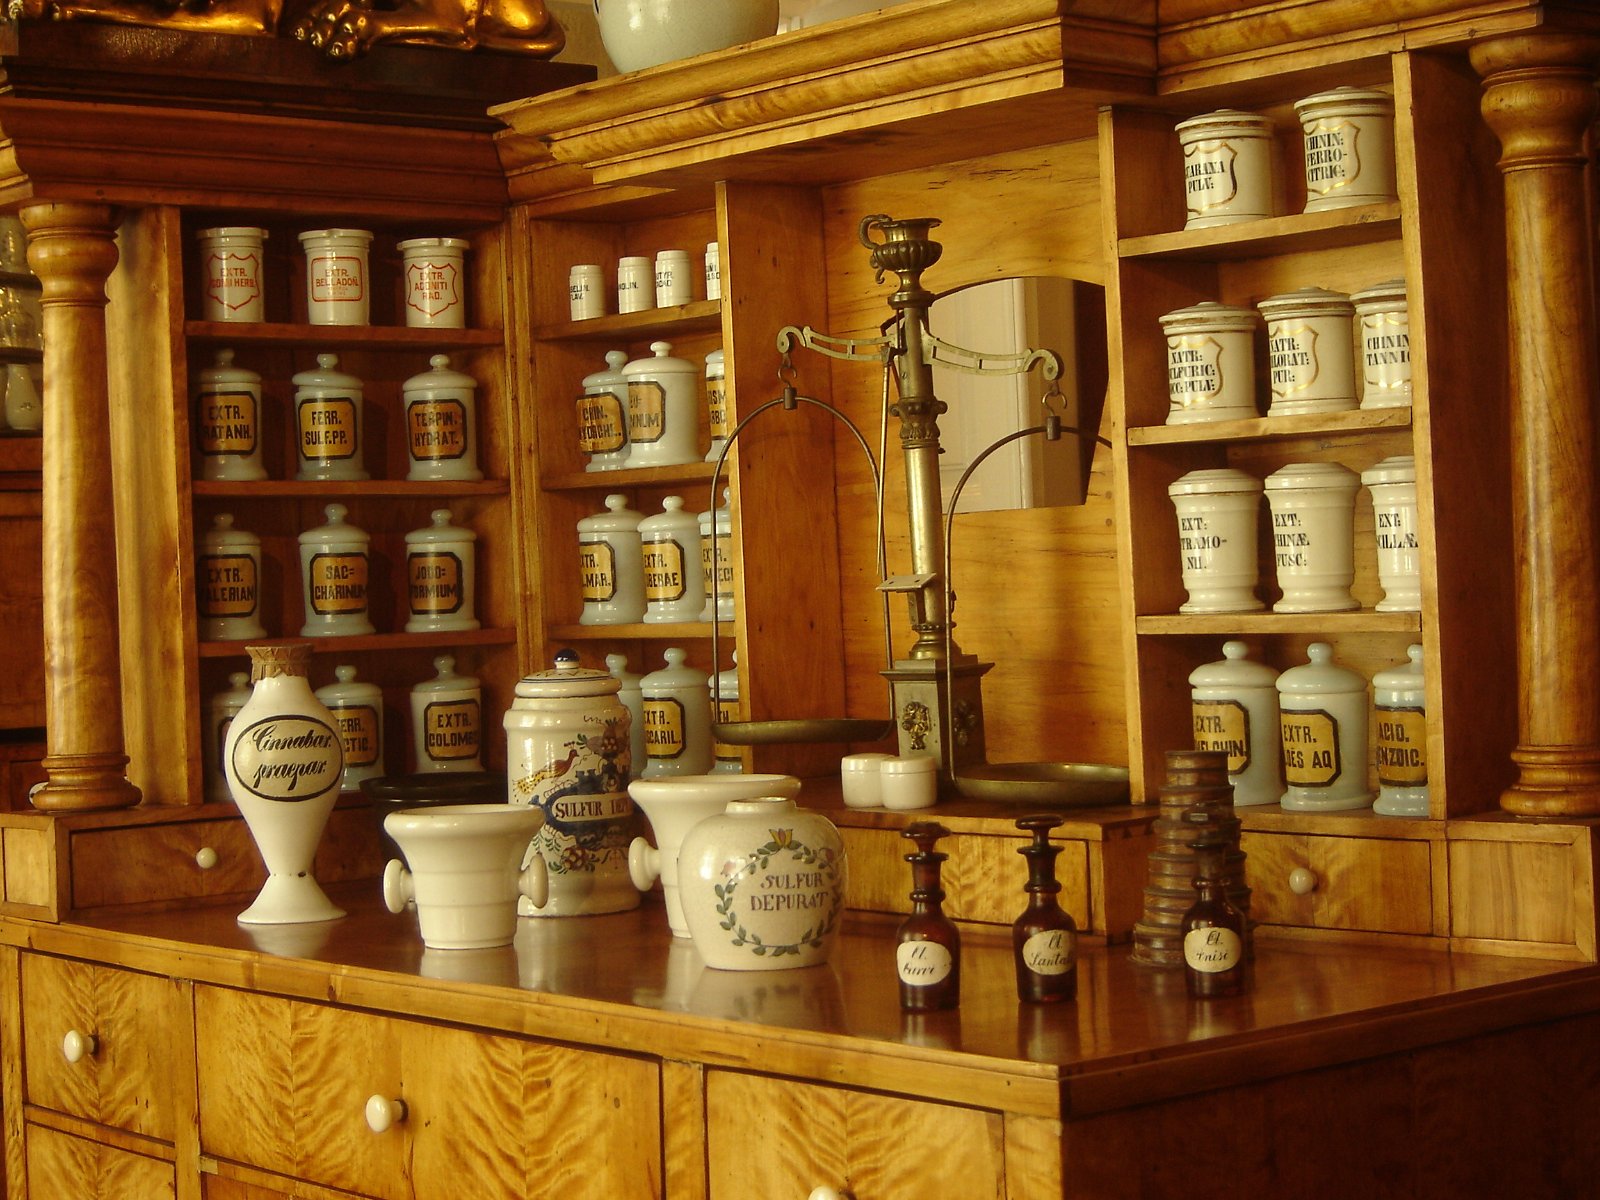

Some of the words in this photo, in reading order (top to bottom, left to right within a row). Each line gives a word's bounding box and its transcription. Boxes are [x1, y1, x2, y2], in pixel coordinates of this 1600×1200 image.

[208, 405, 245, 421] EXTR.
[311, 411, 342, 425] FERR.
[414, 431, 459, 448] HYDRAT.
[1181, 517, 1208, 532] EXT:
[1275, 513, 1302, 528] EXT:
[1378, 513, 1401, 528] EXT:
[1180, 534, 1228, 550] TRAMO-
[703, 548, 727, 563] EXR.
[208, 567, 244, 583] EXTR.
[202, 586, 255, 602] ALERIAN
[336, 718, 366, 733] ERR.
[437, 713, 473, 729] EXTR.
[1284, 724, 1318, 743] EXTR.
[1379, 722, 1410, 742] ACID.
[344, 736, 373, 753] CTIC.
[555, 800, 603, 819] SULFUR
[761, 871, 824, 890] SULFUR
[750, 891, 829, 912] DEPURAT
